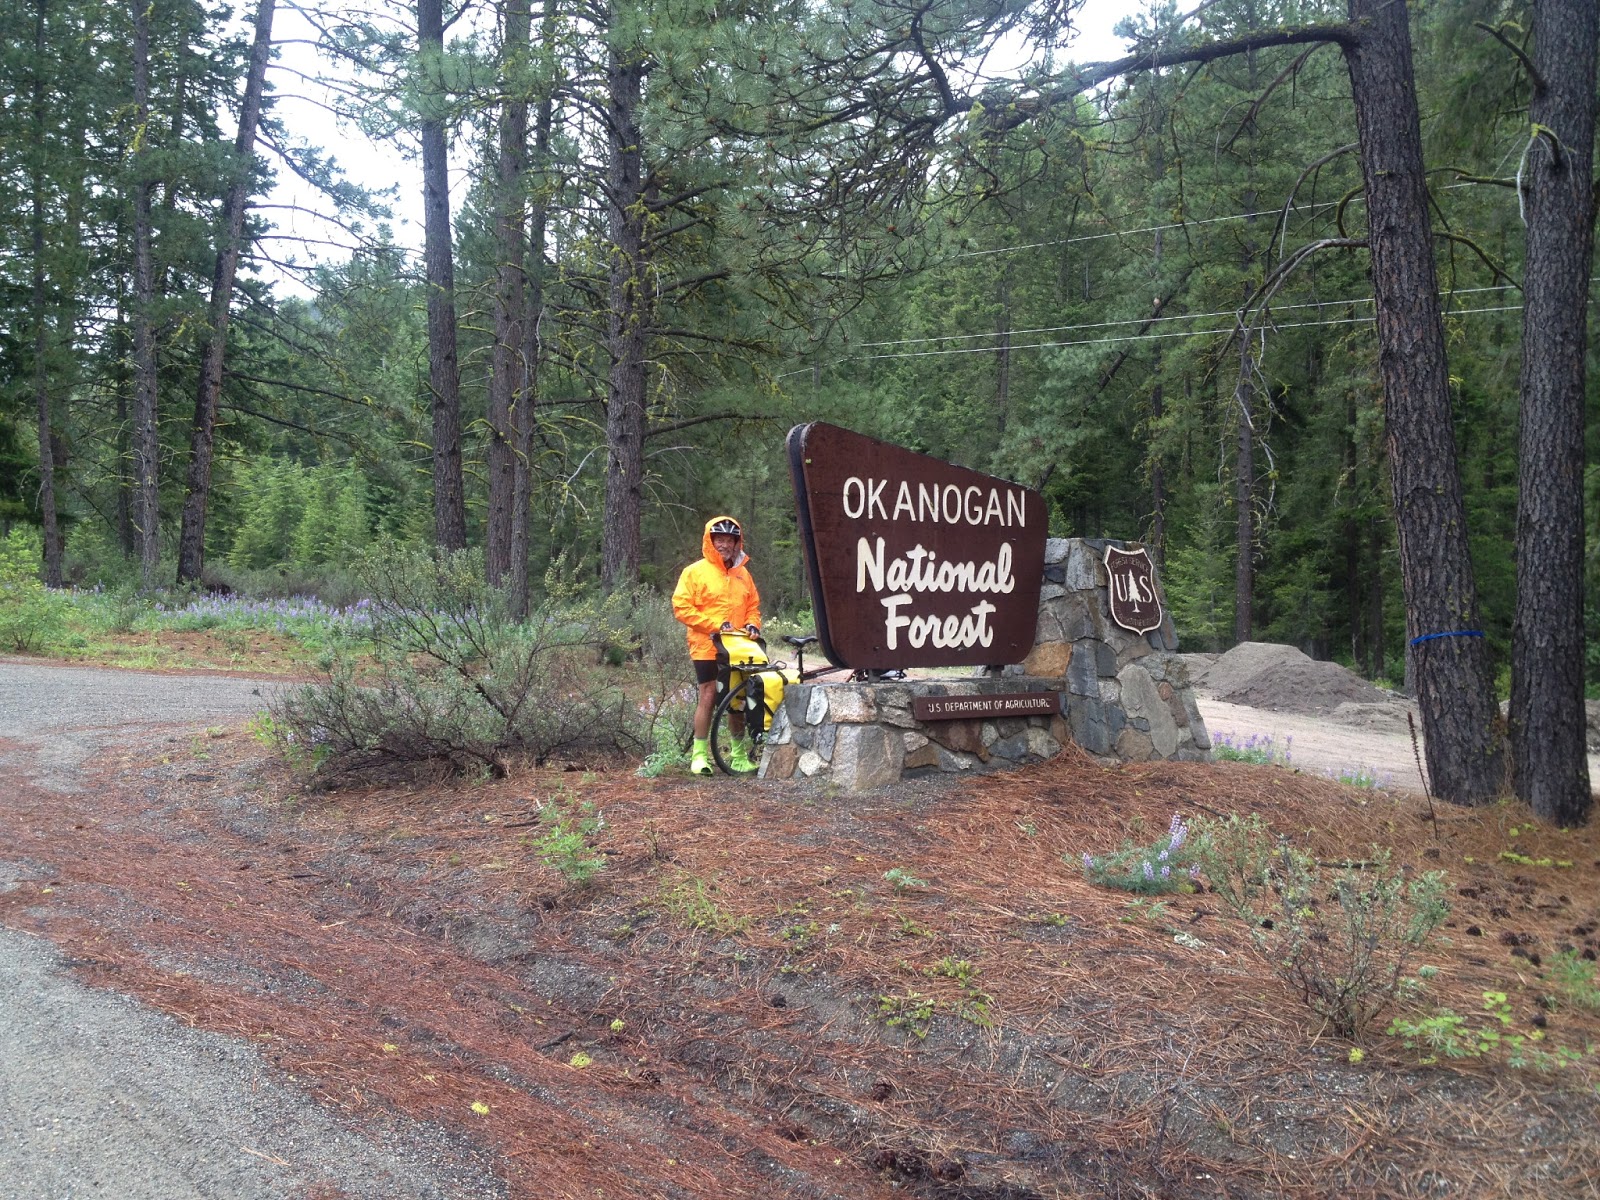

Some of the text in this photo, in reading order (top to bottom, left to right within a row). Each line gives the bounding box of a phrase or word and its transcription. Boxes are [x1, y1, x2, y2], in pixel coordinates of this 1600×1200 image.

[843, 477, 1026, 527] OKANOGAN
[856, 536, 1015, 594] National
[880, 593, 997, 650] Forest
[945, 701, 992, 712] DEPARTMENT
[994, 700, 1003, 710] OF
[1005, 698, 1052, 709] AGRICULTURE
